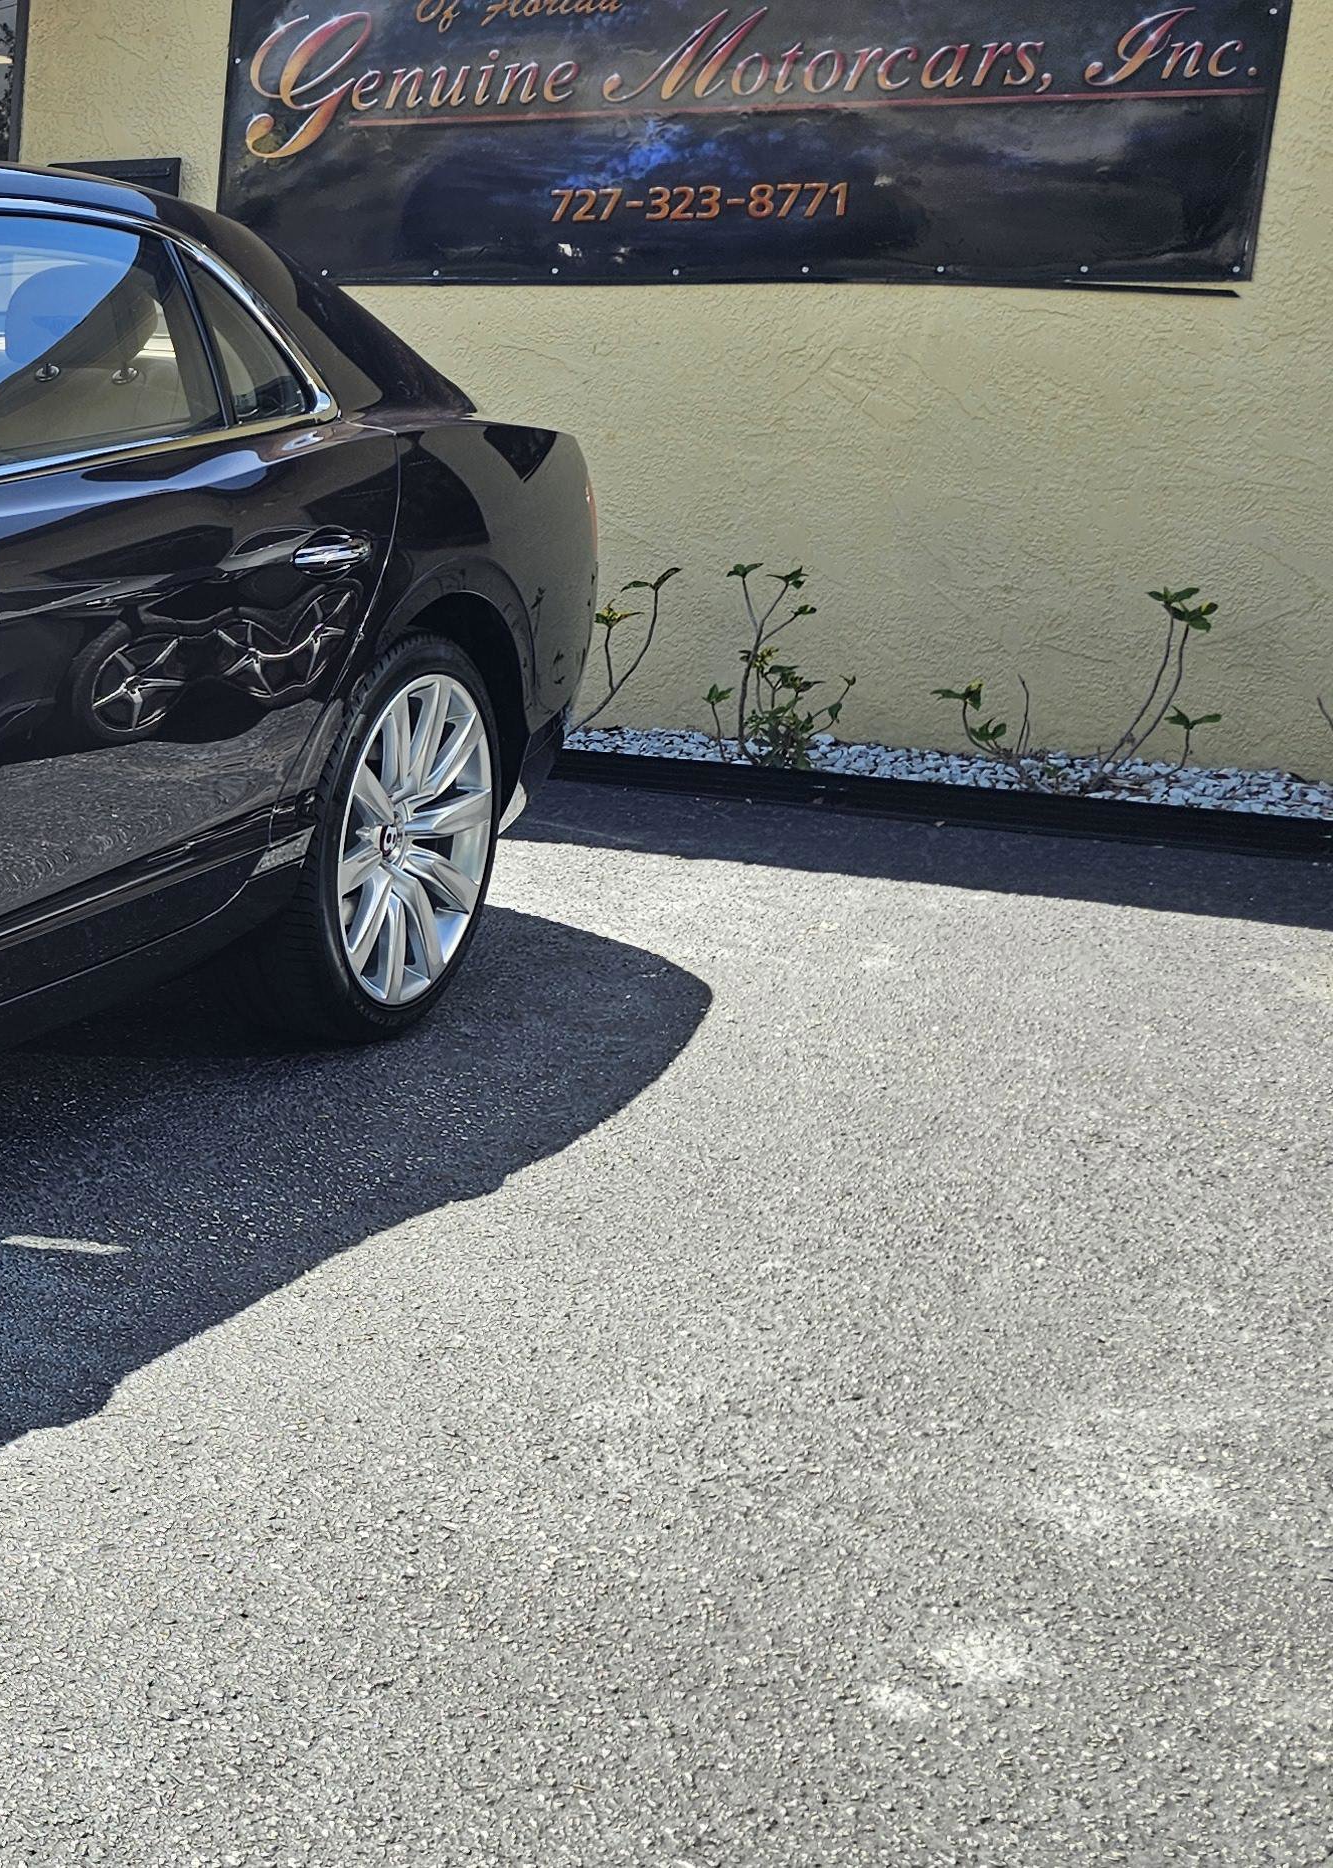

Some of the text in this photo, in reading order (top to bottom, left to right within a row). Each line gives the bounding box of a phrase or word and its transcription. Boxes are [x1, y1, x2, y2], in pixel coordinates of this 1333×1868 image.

[245, 6, 1258, 159] Genuine Motorcars, Inc.
[550, 181, 849, 222] 727-323-8771
